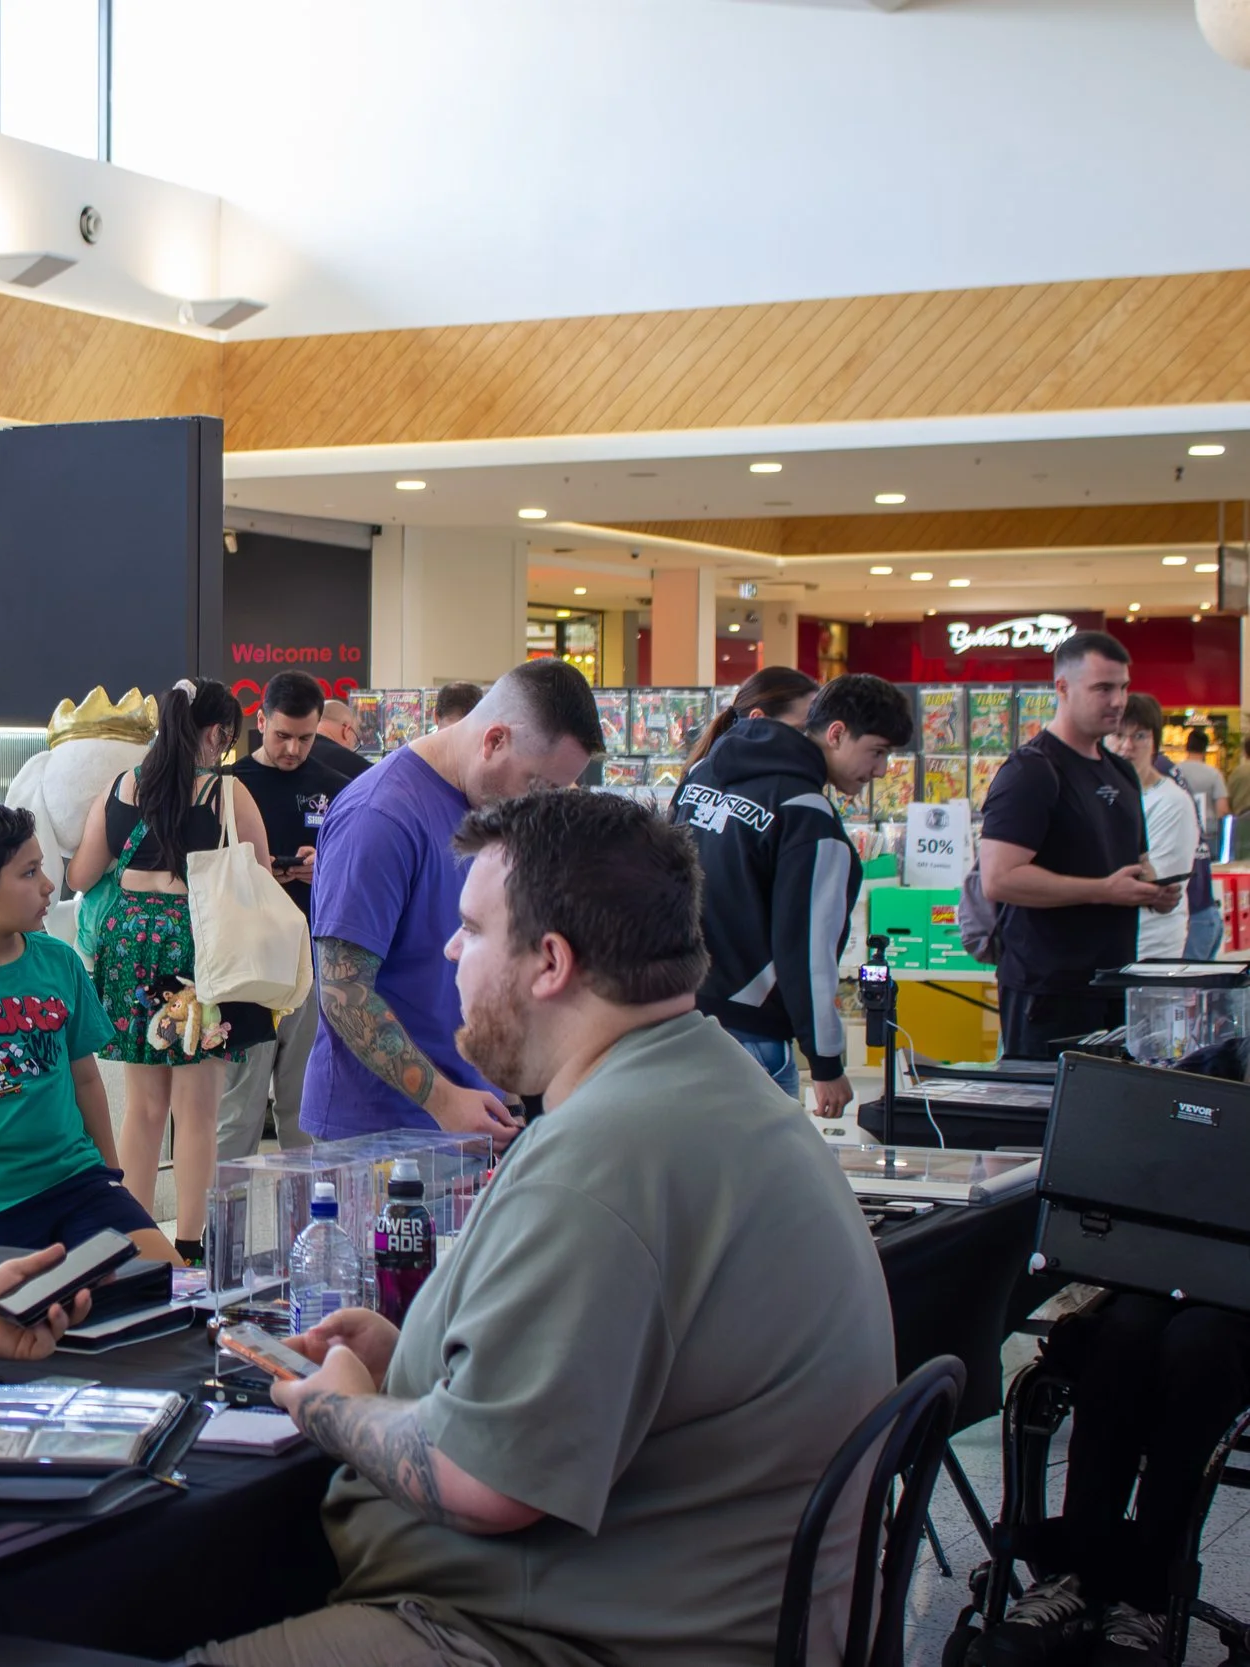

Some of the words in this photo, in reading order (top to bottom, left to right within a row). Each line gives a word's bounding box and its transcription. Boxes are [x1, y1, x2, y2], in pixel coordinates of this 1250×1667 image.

[231, 642, 333, 664] Welcome
[338, 643, 362, 663] to
[916, 838, 955, 856] 50%
[1179, 1102, 1213, 1117] VEVOR
[387, 1234, 424, 1253] ADE
